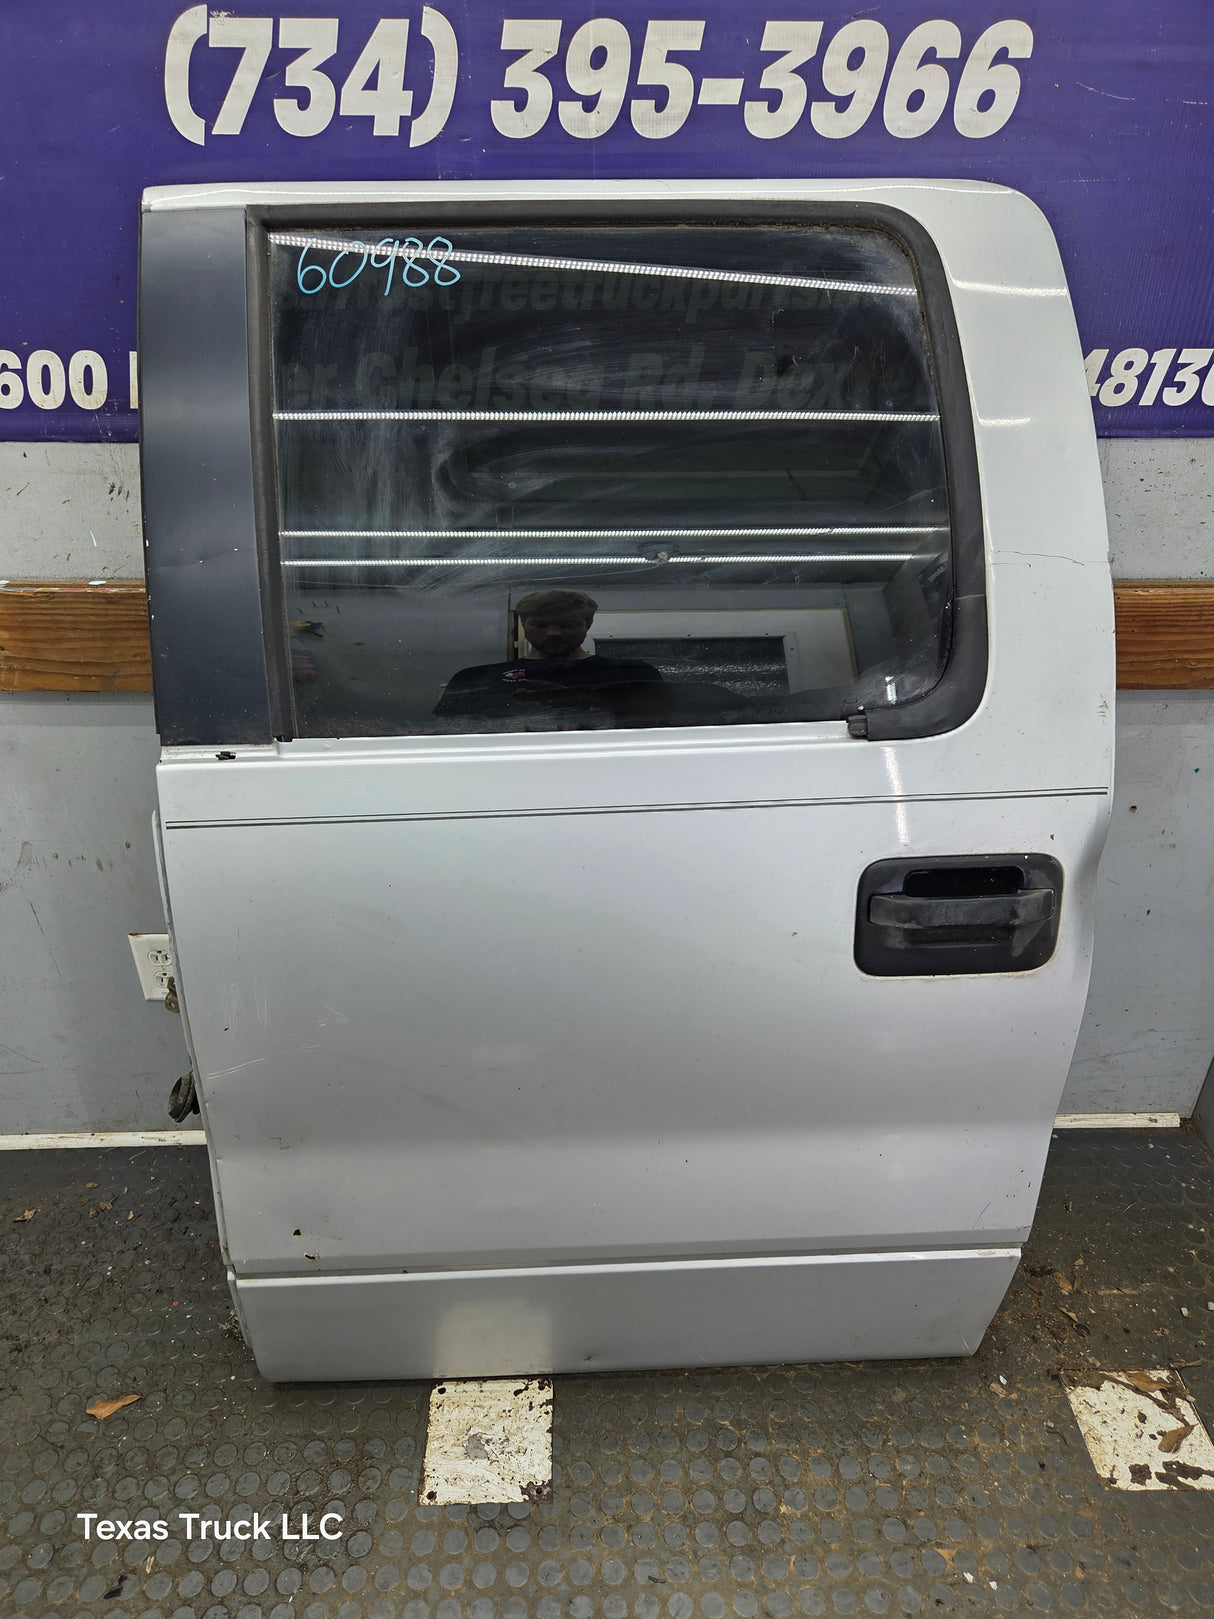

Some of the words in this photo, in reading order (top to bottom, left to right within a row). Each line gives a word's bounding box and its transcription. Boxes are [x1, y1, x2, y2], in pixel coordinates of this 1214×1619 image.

[164, 5, 458, 147] (734)
[490, 17, 1034, 139] 395-3966
[297, 236, 461, 296] 60988
